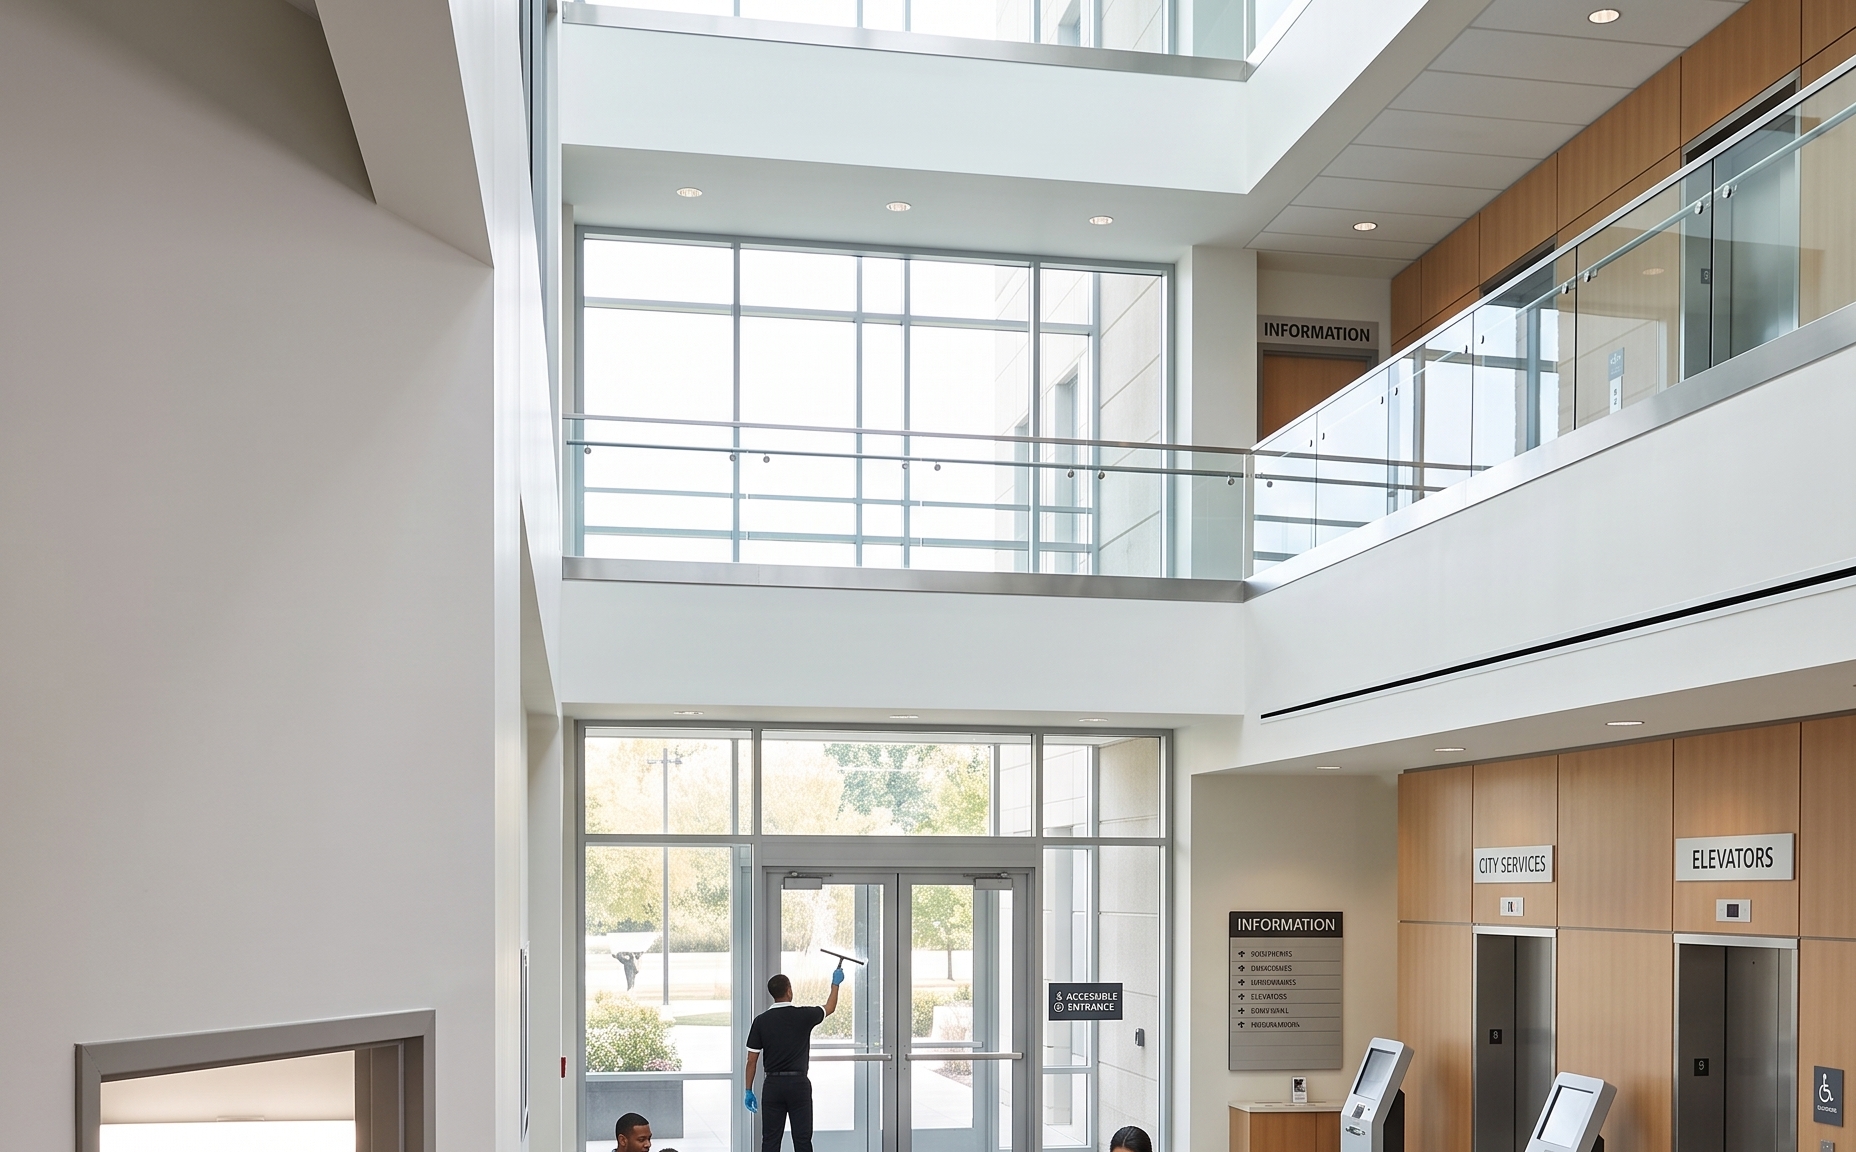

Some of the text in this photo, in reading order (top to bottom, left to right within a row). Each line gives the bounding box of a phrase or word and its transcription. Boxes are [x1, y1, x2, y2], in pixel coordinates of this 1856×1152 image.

[1264, 322, 1370, 342] INFORMATION
[1479, 855, 1546, 874] CITY SERVICES
[1692, 846, 1774, 870] ELEVATORS
[1237, 918, 1336, 931] INFORMATION
